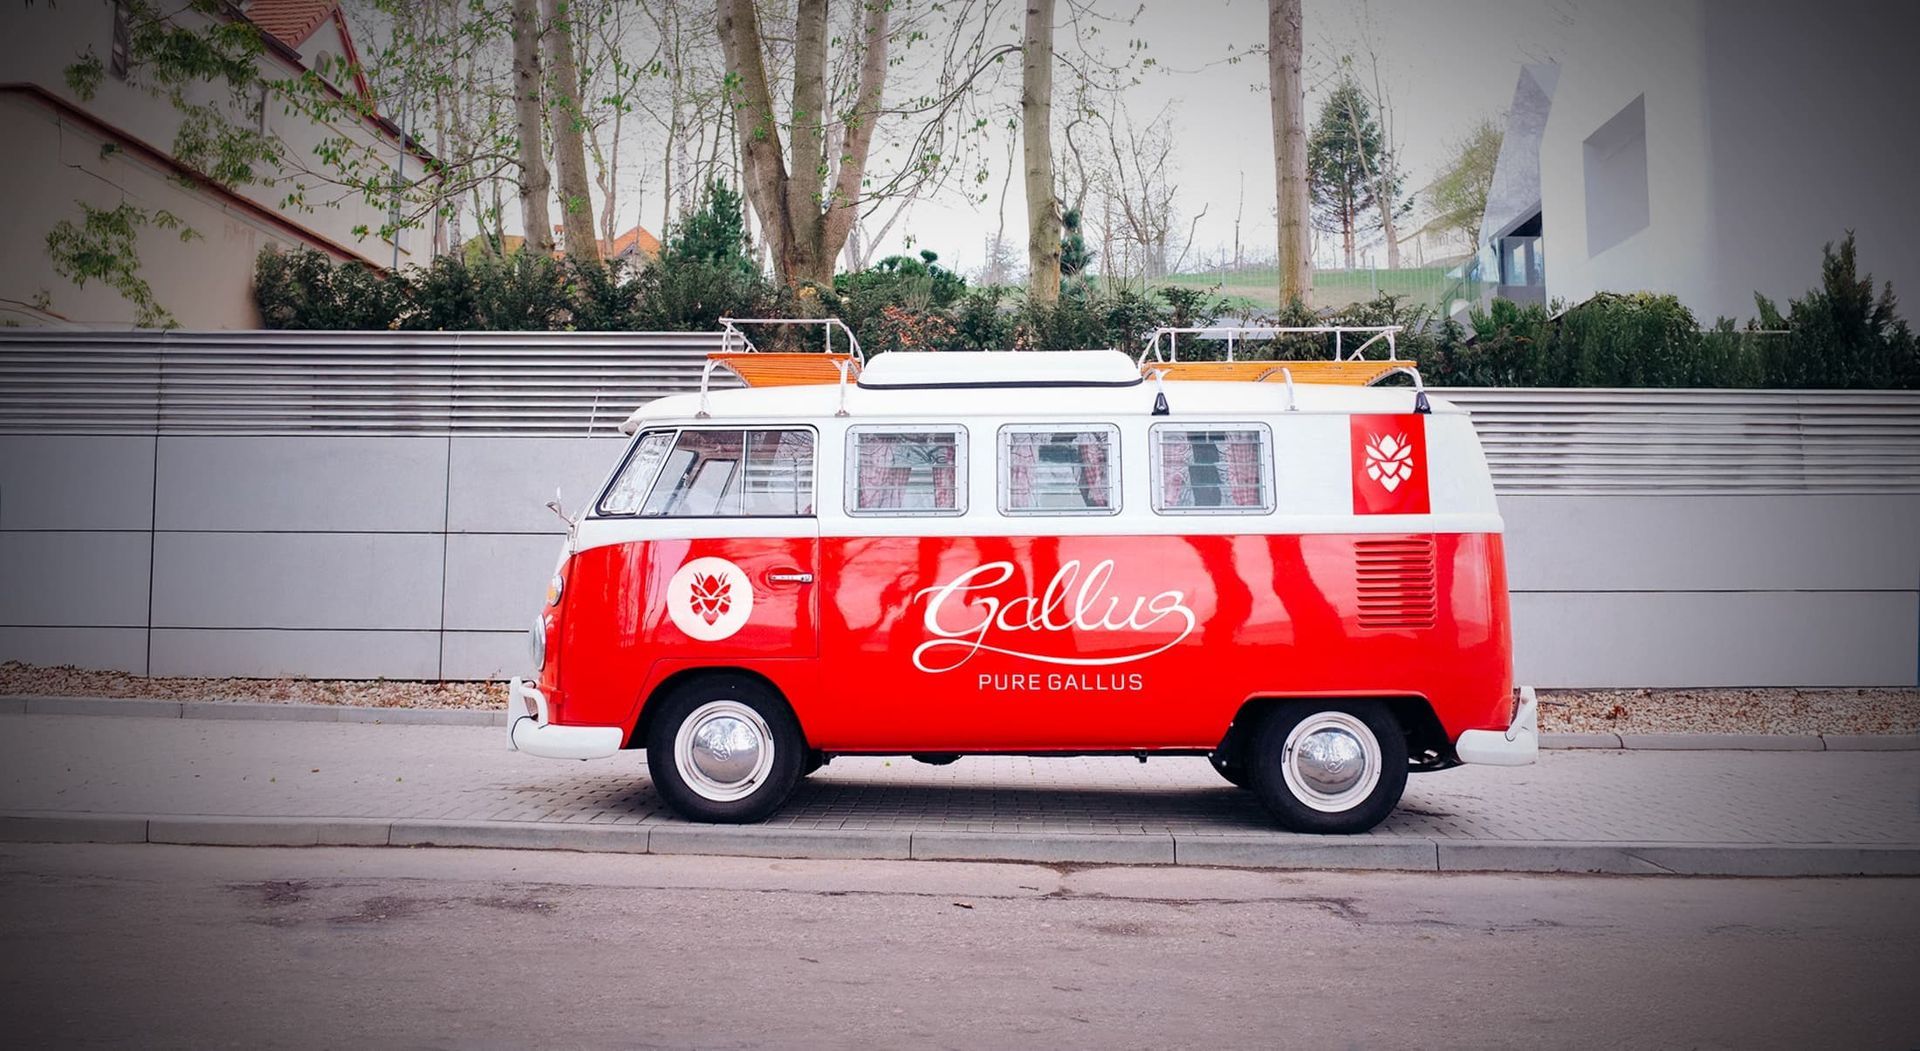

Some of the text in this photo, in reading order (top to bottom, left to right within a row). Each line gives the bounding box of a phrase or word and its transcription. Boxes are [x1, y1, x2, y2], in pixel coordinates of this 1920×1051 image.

[912, 559, 1196, 673] Gallus
[978, 673, 1143, 691] PURE GALLUS
